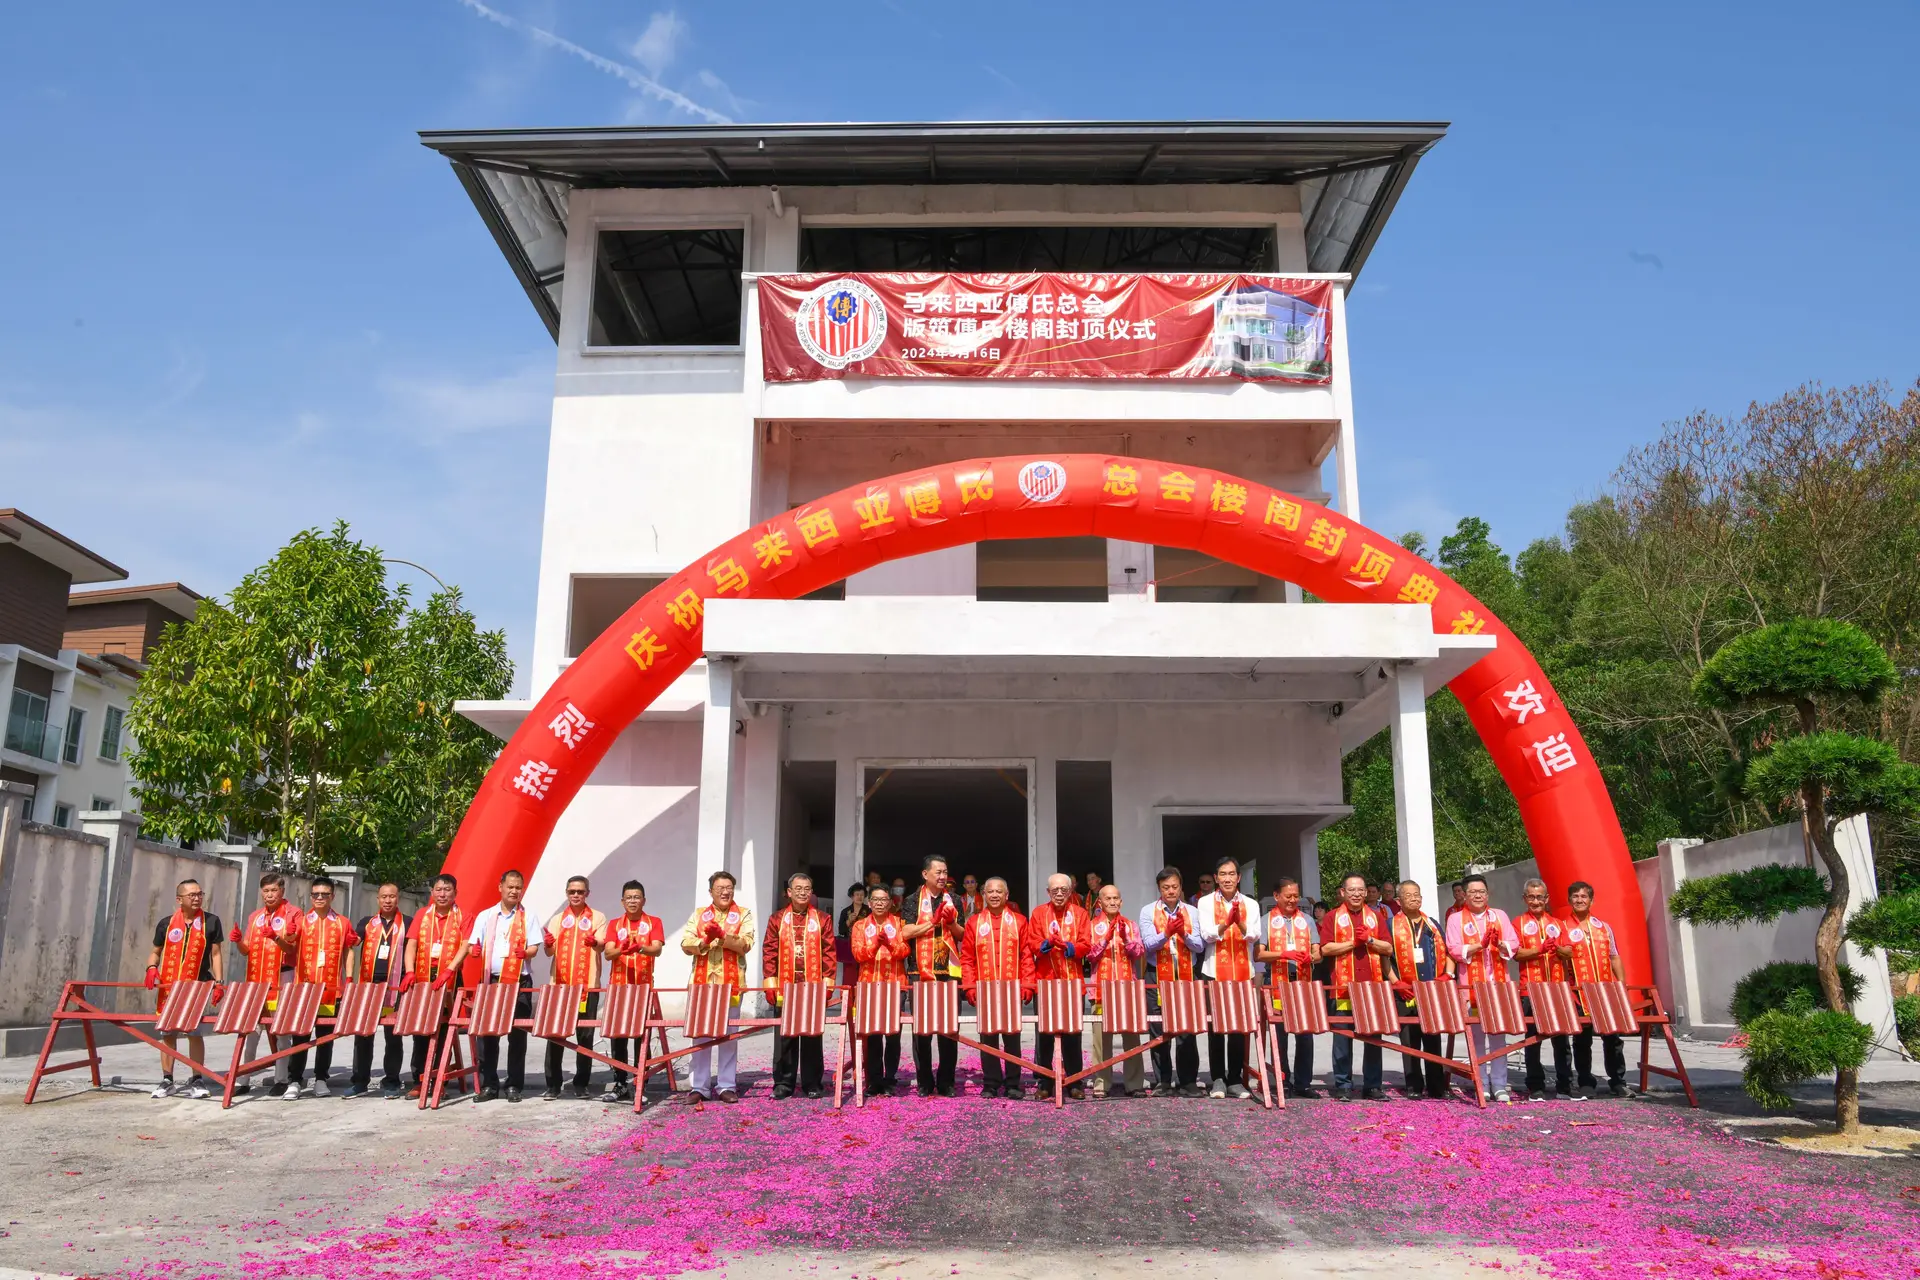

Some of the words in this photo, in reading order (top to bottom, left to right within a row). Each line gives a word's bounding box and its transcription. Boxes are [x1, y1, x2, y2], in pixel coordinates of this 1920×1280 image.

[903, 291, 1106, 317] 马来西亚傅氏总会
[902, 317, 1157, 341] 版筑傅氏楼阁封顶仪式
